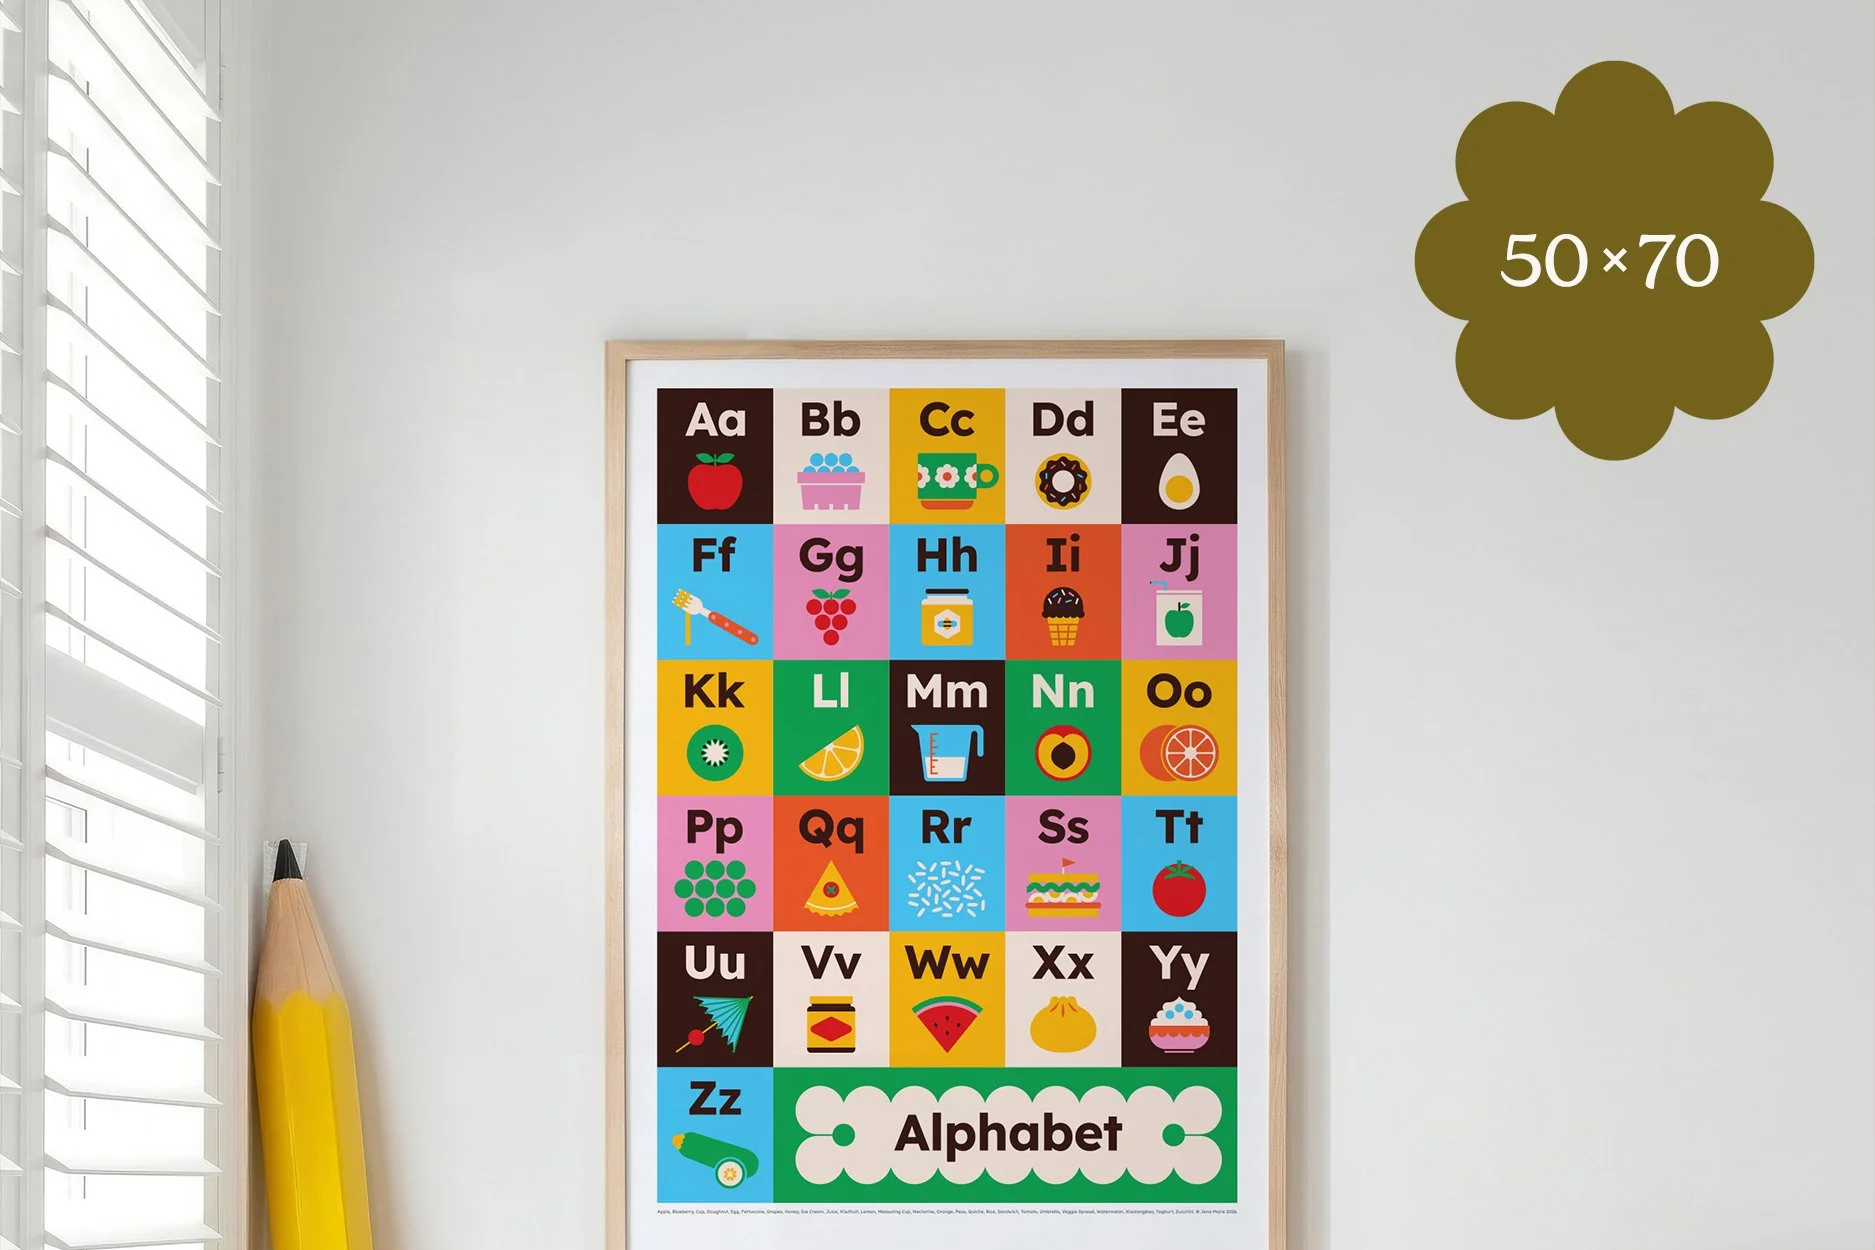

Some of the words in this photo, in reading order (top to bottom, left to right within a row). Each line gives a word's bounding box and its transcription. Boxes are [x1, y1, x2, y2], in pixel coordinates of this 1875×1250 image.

[685, 402, 745, 436] Aa
[802, 400, 860, 437] Bb
[920, 402, 974, 436] Cc
[1033, 400, 1094, 436] Dd
[1153, 402, 1205, 436] Ee
[693, 536, 737, 572] Ff
[799, 537, 863, 582] Gg
[918, 536, 977, 572] Hh
[1047, 534, 1080, 571] Ii
[1159, 534, 1200, 581] Jj
[685, 672, 744, 708] Kk
[814, 672, 848, 708] Ll
[907, 674, 987, 708] Mm
[1033, 674, 1094, 708] Nn
[1147, 673, 1212, 708] Oo
[687, 810, 743, 854] Pp
[799, 809, 863, 853] Qq
[922, 810, 972, 843] Rr
[1038, 809, 1089, 844] Ss
[1156, 810, 1203, 843] Tt
[686, 945, 745, 980] Uu
[801, 945, 862, 979] Vv
[905, 945, 990, 979] Ww
[1032, 945, 1094, 979] Xx
[1149, 945, 1210, 990] Yy
[689, 1081, 741, 1115] Zz
[894, 1112, 1123, 1162] Alphabet
